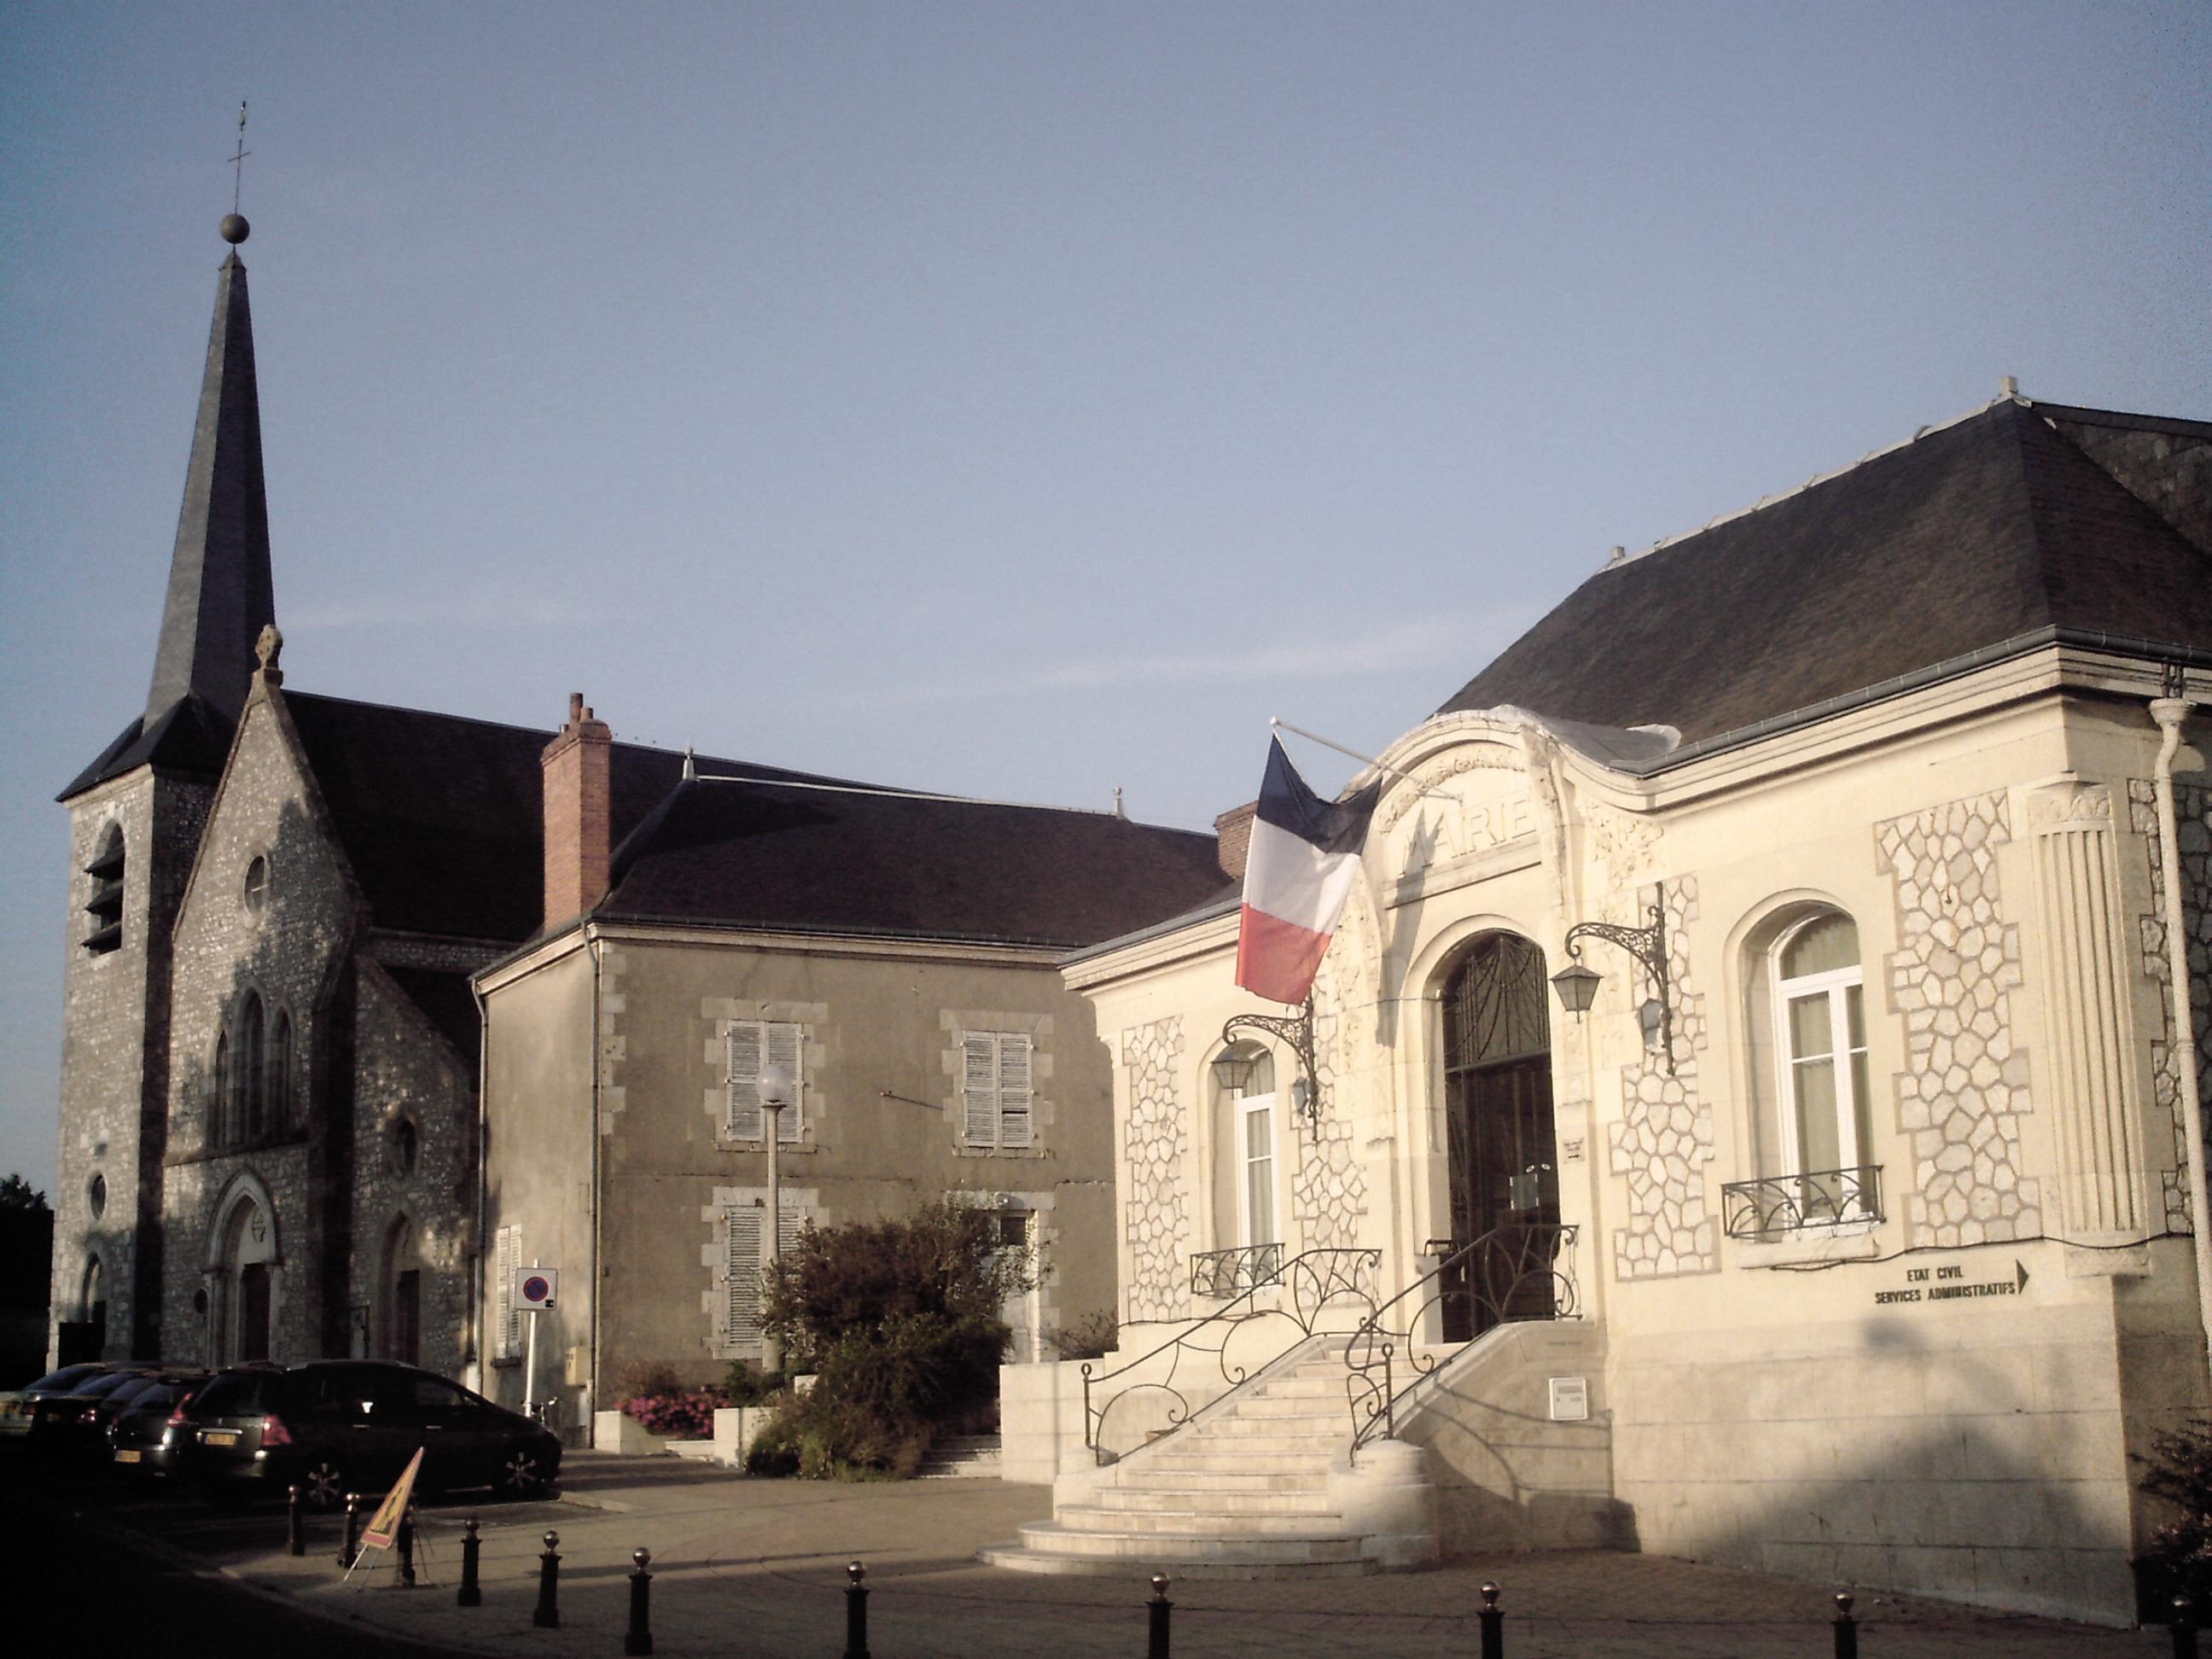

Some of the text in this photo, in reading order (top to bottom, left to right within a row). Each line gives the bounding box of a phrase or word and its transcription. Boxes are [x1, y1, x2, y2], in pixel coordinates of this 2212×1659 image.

[1906, 1266, 1963, 1282] ETAT CIVIL
[1875, 1283, 2015, 1304] SERVICES ADMINISTRATIFS
